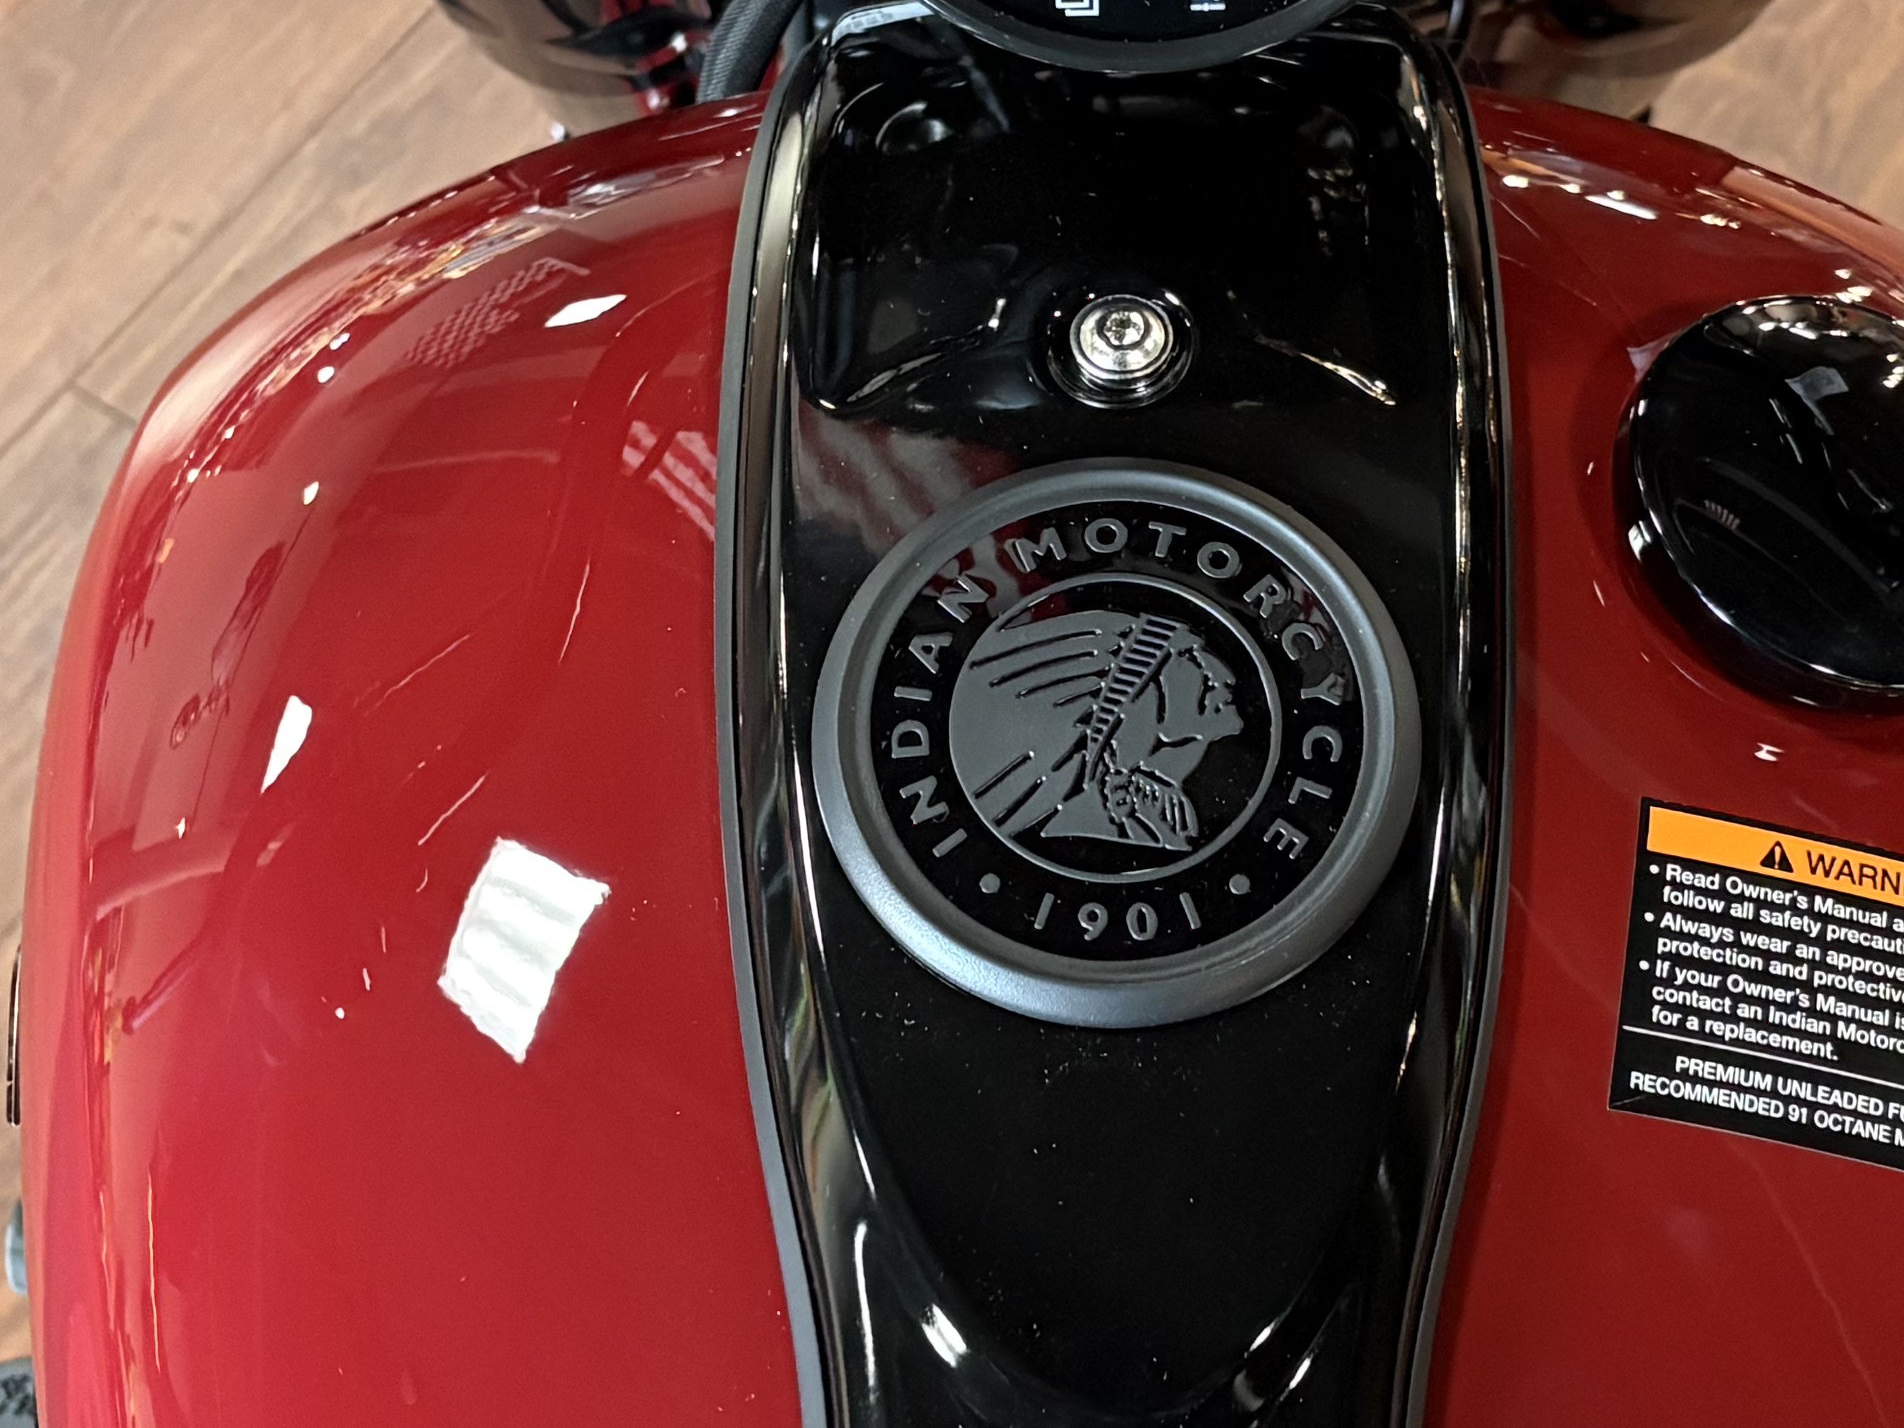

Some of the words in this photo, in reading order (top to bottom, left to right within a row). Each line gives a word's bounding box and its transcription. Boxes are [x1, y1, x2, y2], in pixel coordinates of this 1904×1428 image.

[890, 570, 991, 858] INDIAN
[1008, 517, 1348, 860] MOTORCYCLE
[1033, 891, 1202, 941] 1901
[1662, 885, 1725, 914] follow
[1729, 900, 1754, 920] all
[1759, 906, 1822, 938] safety
[1664, 863, 1720, 891] Read
[1725, 875, 1809, 910] Owner's
[1813, 895, 1888, 928] Manual
[1656, 937, 1764, 971] protection
[1768, 959, 1809, 981] and
[1659, 911, 1735, 943] Always
[1739, 930, 1792, 954] wear
[1795, 942, 1822, 961] an
[1651, 985, 1732, 1015] contact
[1736, 1001, 1763, 1021] an
[1768, 1005, 1831, 1035] Indian
[1655, 958, 1672, 979] If
[1674, 967, 1723, 989] your
[1726, 973, 1811, 1009] Owner's
[1815, 993, 1890, 1027] Manual
[1651, 1004, 1681, 1026] for
[1685, 1014, 1700, 1032] a
[1704, 1019, 1839, 1061] replacement.
[1629, 1070, 1785, 1119] RECOMMENDED
[1787, 1103, 1808, 1124] 91
[1813, 1110, 1893, 1145] OCTANE
[1674, 1055, 1773, 1092] PREMIUM
[1777, 1079, 1884, 1117] UNLEADED
